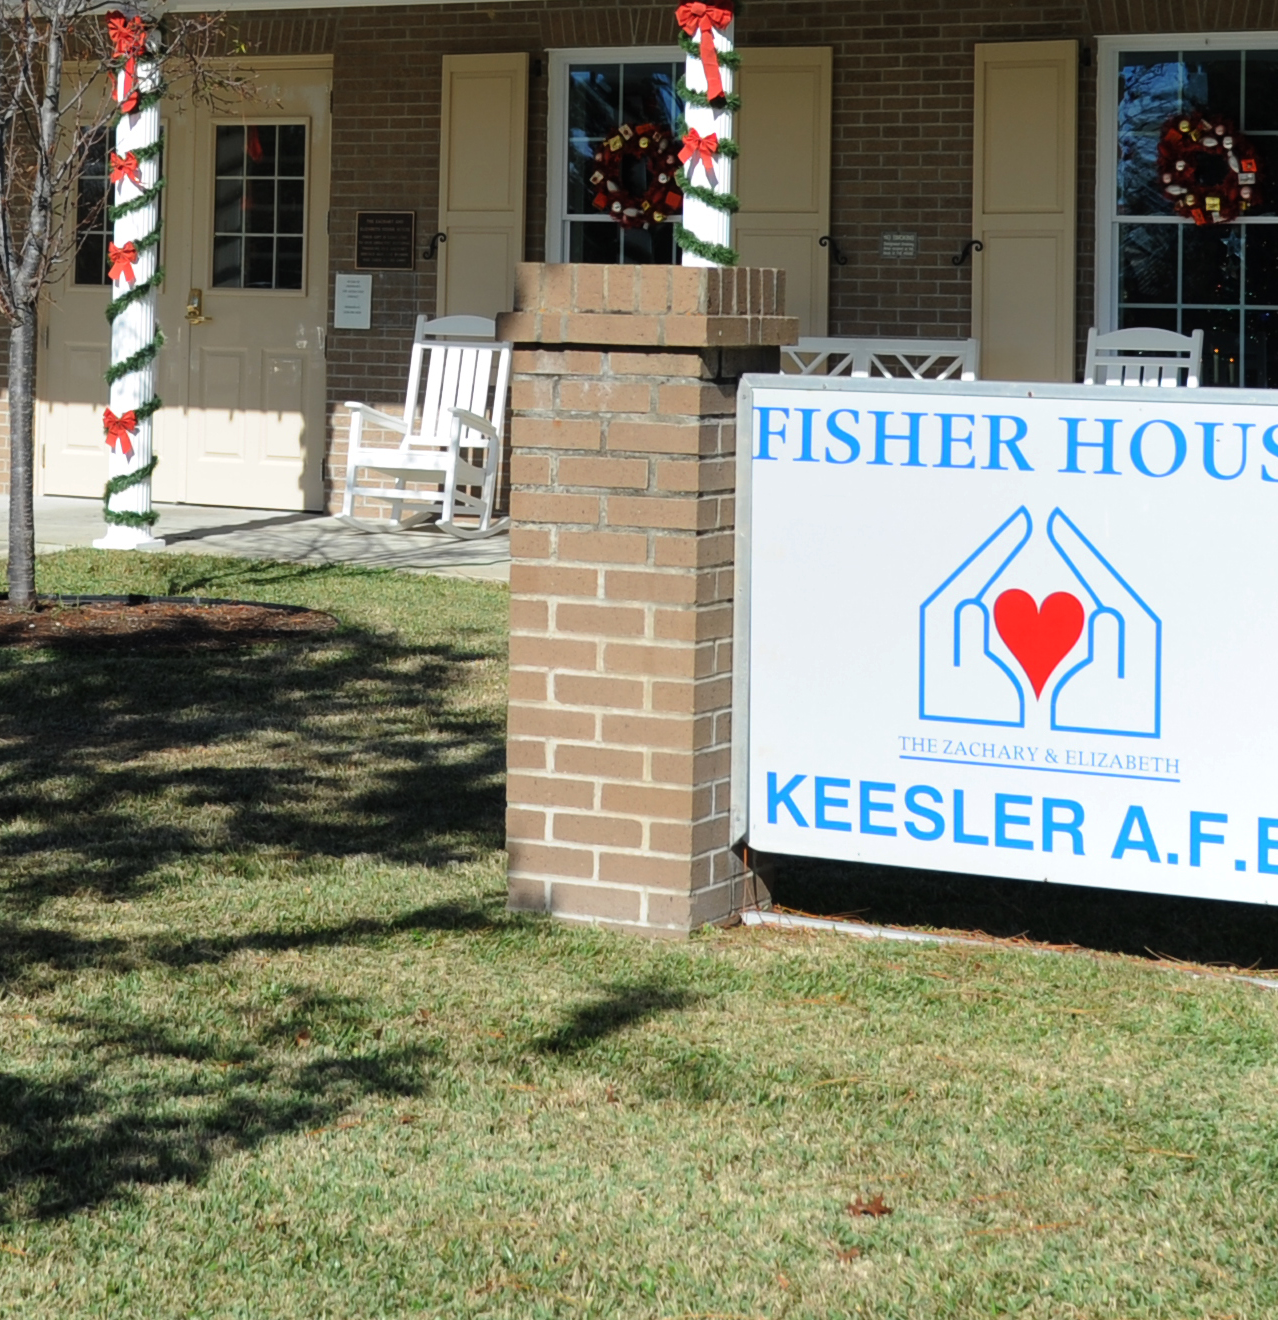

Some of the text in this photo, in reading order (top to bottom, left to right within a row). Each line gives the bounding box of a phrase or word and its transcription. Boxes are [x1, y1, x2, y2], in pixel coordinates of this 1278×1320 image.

[752, 406, 1035, 472] FISHER
[898, 735, 1181, 774] THE ZACHARY & ELIZABETH
[767, 770, 1086, 856] KEESLER
